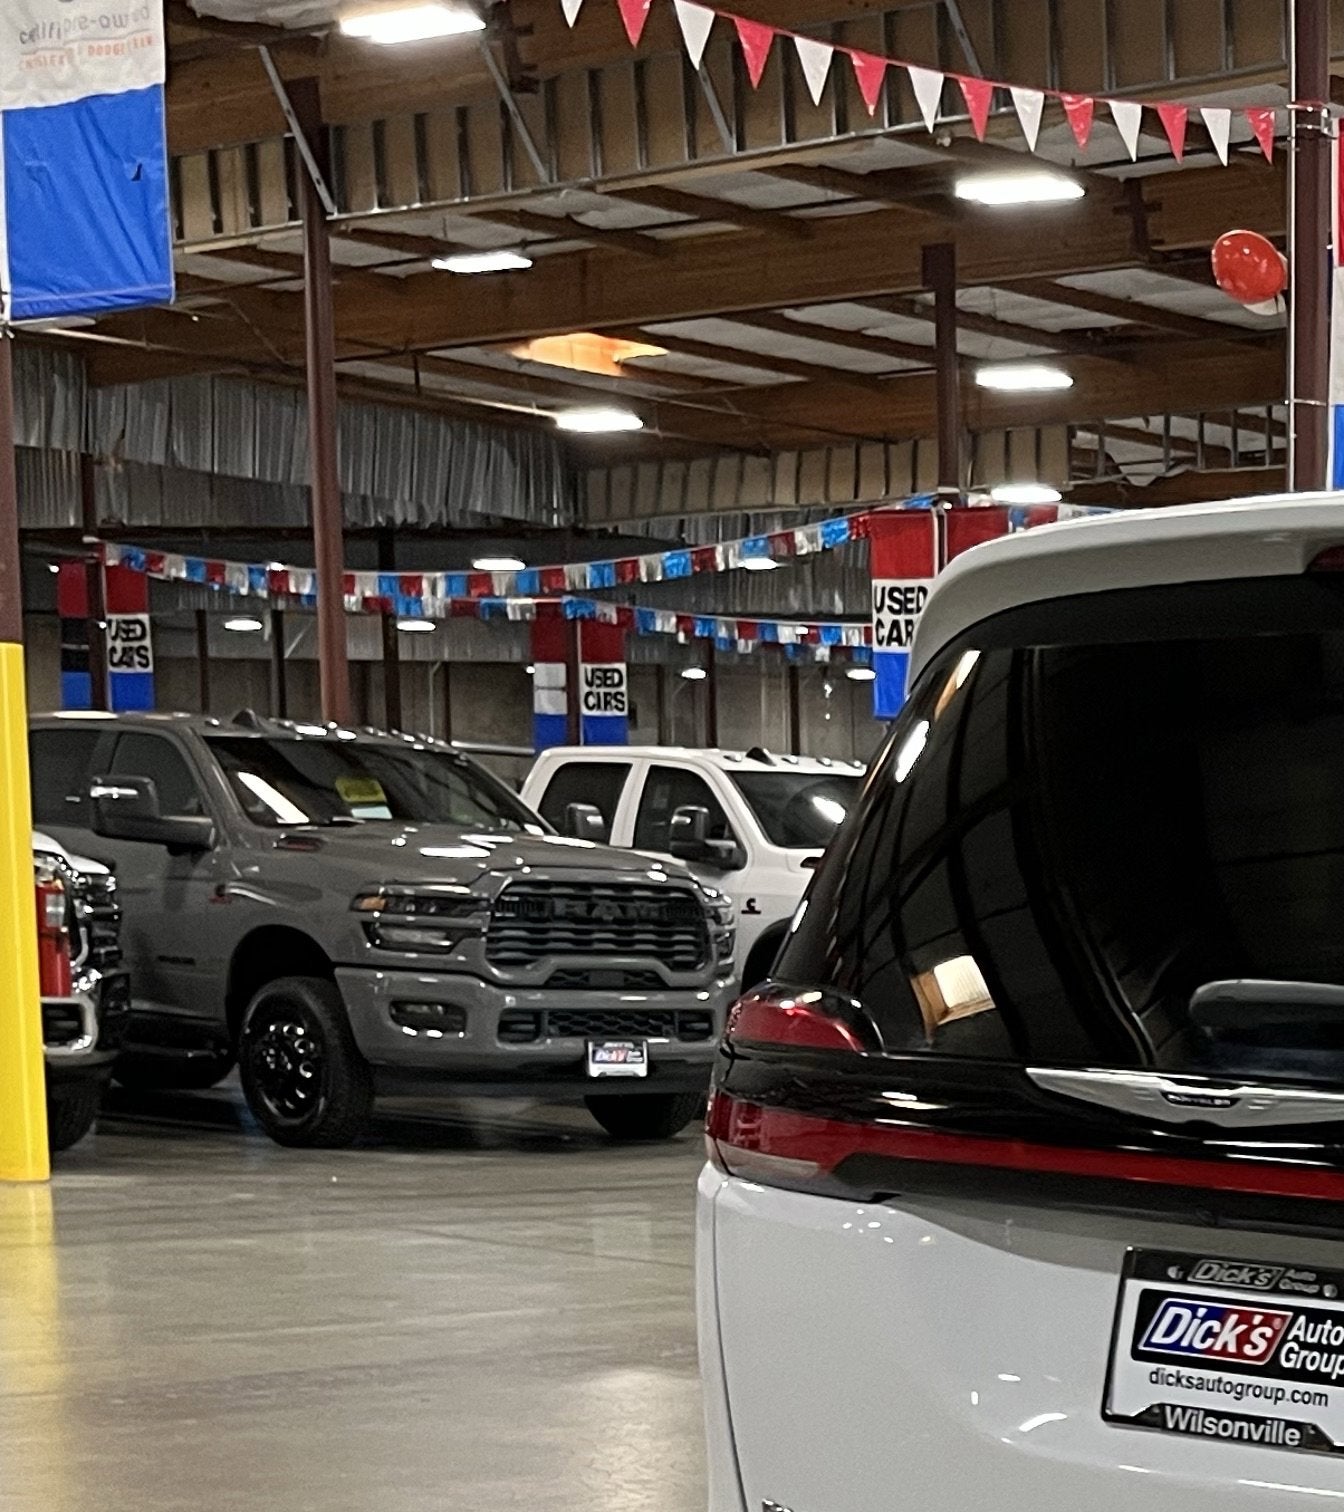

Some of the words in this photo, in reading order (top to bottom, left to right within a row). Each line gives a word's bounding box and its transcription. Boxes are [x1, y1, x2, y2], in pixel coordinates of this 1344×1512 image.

[874, 586, 928, 615] USED
[875, 618, 915, 647] CAR
[584, 667, 624, 688] USED
[1195, 1262, 1272, 1287] Dick's
[1150, 1306, 1273, 1357] Dick's
[1149, 1367, 1329, 1407] dicksautogroup.com
[1165, 1405, 1301, 1447] Wilsonville
